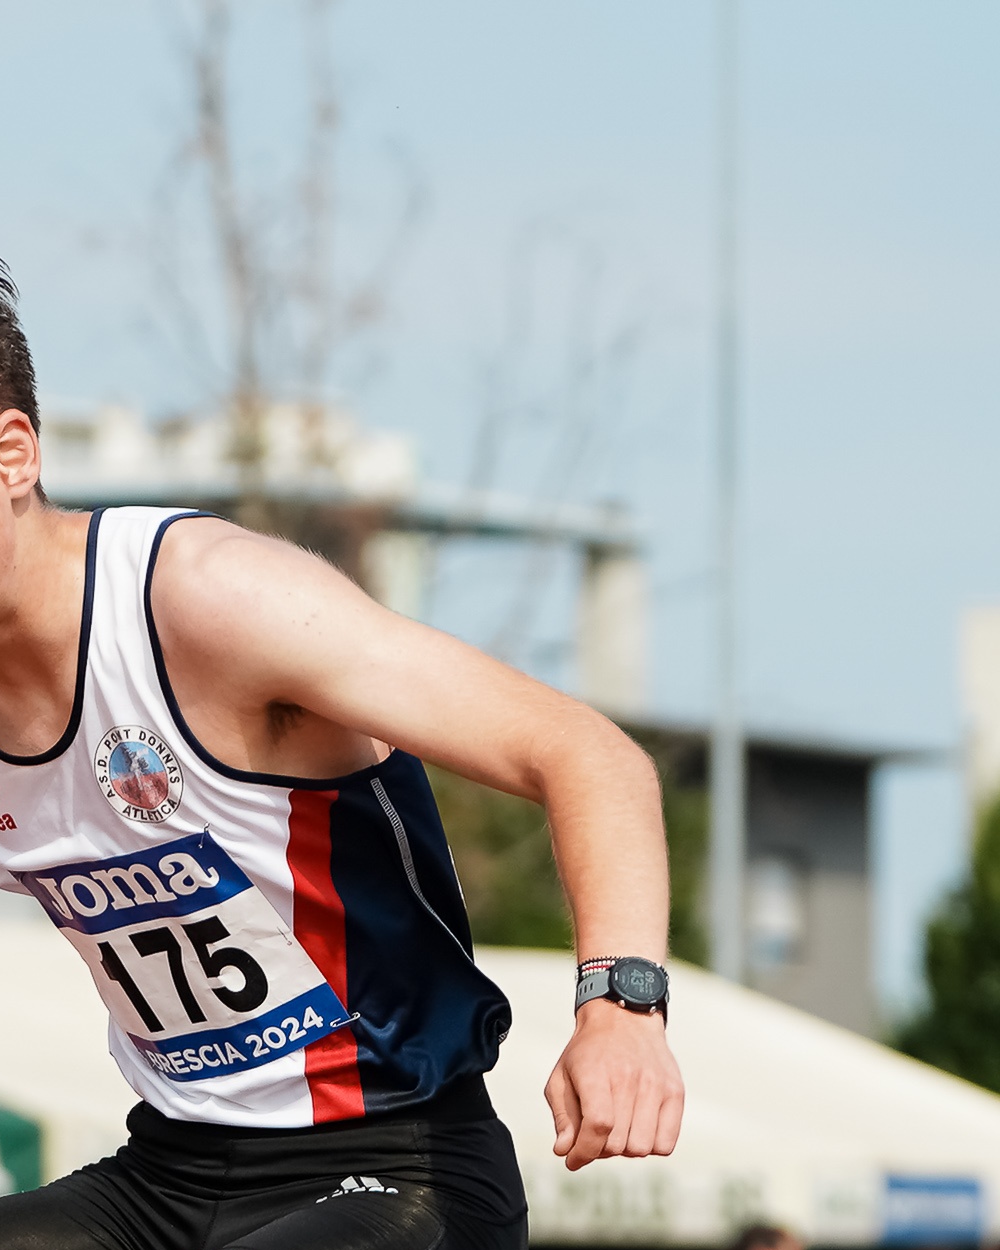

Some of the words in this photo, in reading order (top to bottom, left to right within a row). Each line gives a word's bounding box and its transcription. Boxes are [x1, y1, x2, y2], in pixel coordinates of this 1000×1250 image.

[139, 731, 180, 784] DONNAS
[97, 915, 268, 1033] 175
[146, 1042, 247, 1074] BRESCIA
[245, 1006, 324, 1057] 2024
